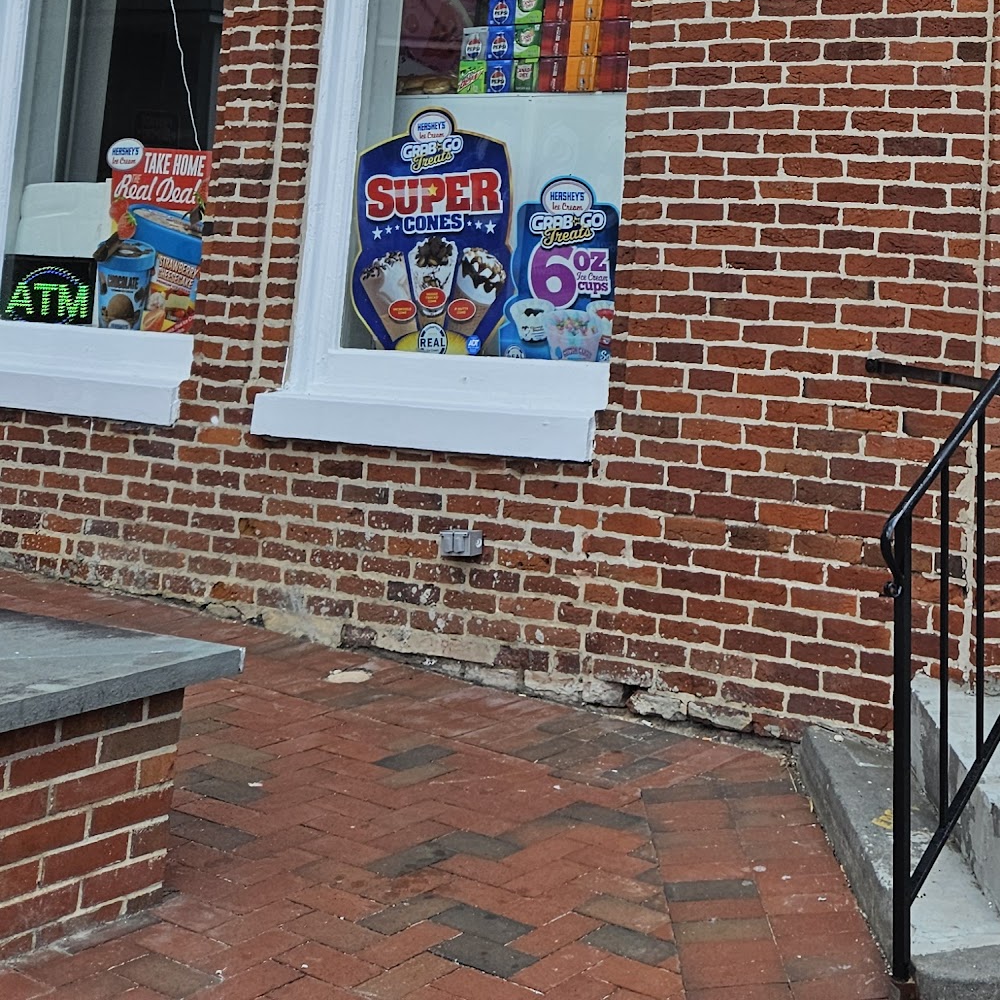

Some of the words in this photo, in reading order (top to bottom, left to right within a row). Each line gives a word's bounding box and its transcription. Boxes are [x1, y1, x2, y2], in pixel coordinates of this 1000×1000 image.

[417, 121, 446, 131] HERSHEY'S
[402, 142, 437, 159] GRAB
[442, 137, 462, 153] GO
[144, 152, 172, 175] TAKE
[172, 154, 206, 177] HOME
[412, 151, 453, 171] Treats
[114, 174, 158, 201] Real
[156, 177, 202, 204] Deal
[367, 171, 500, 218] SUPER
[550, 191, 585, 201] HERSHEY'S
[552, 202, 560, 210] Ice
[562, 202, 583, 211] Cream
[403, 214, 461, 231] CONES
[532, 214, 573, 231] GRAB
[581, 212, 604, 228] GO
[543, 225, 592, 246] Treats
[530, 247, 577, 307] 6
[573, 250, 607, 272] OZ
[576, 272, 587, 280] Ice
[587, 272, 608, 282] Cream
[577, 281, 608, 295] cups
[5, 282, 89, 318] ATM
[420, 338, 446, 348] REAL
